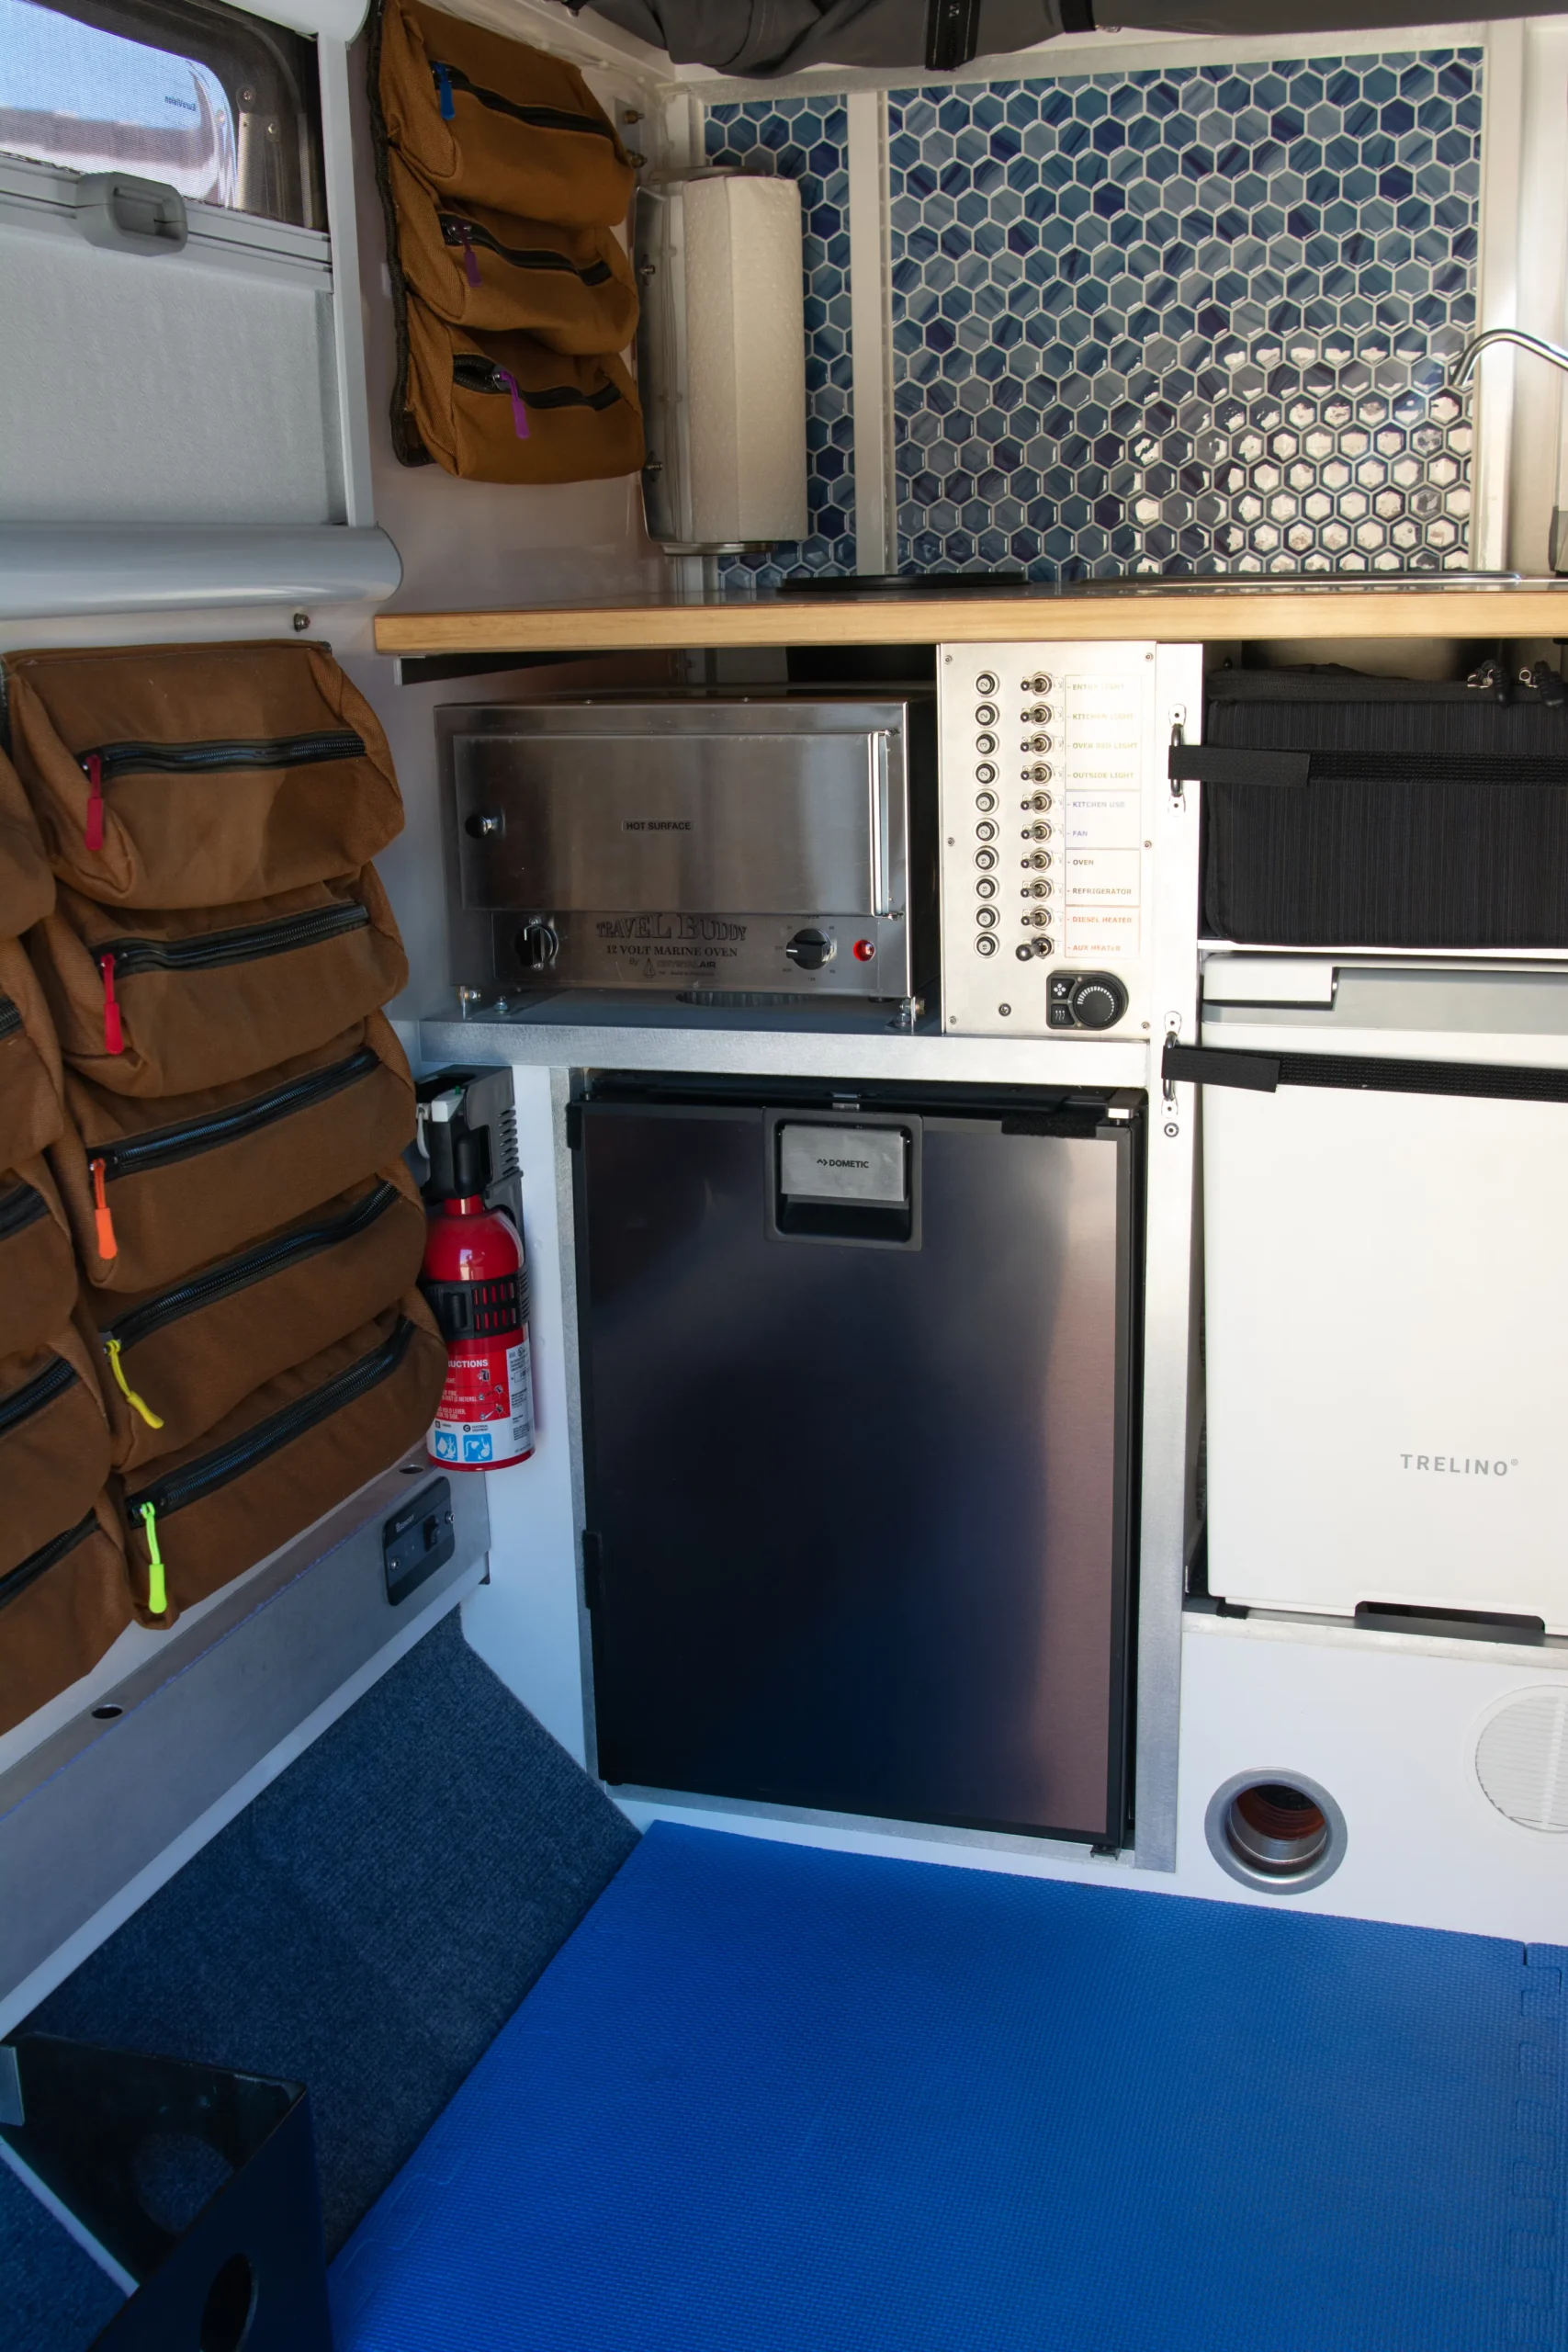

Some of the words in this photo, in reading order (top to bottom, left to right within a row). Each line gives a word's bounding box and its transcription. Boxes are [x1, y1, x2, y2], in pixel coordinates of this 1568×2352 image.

[626, 821, 646, 831] HOT
[648, 821, 692, 831] SURFACE
[1072, 858, 1095, 866] OVEN
[1072, 888, 1133, 896] REFRIGERATOR
[1101, 916, 1133, 924] HEATER
[595, 912, 671, 939] TRAVEL
[677, 912, 748, 942] BUDDY
[606, 944, 617, 955] 12
[619, 944, 651, 956] VOLT
[653, 945, 702, 956] MARINE
[704, 946, 739, 957] OVEN
[1090, 944, 1122, 953] HEATER
[698, 960, 716, 969] AIR
[829, 1159, 870, 1169] DOMETIC
